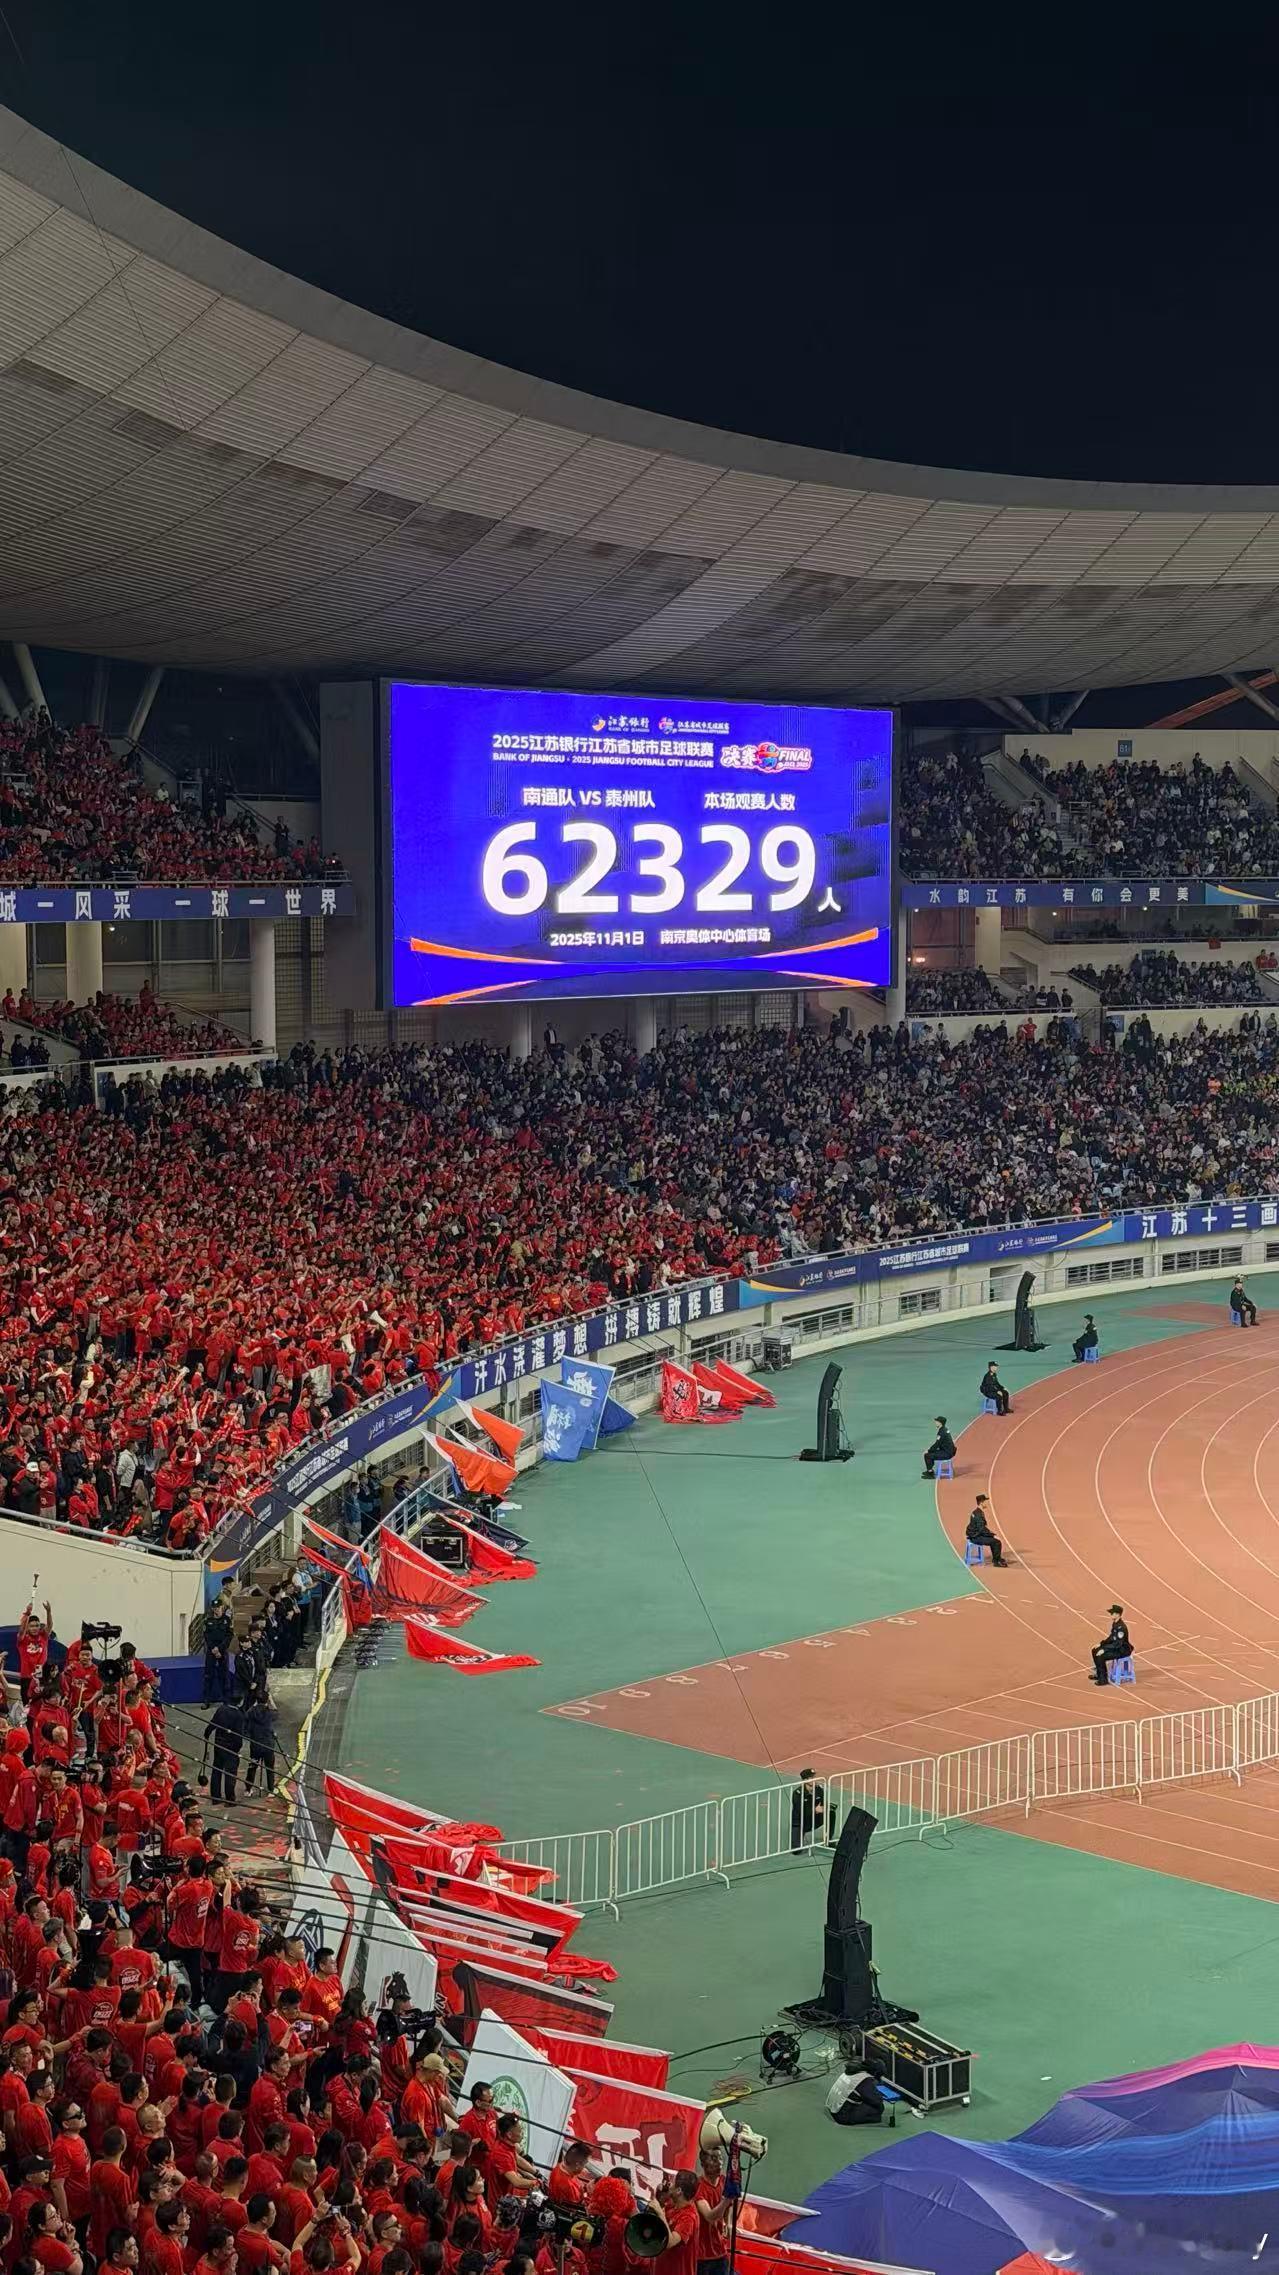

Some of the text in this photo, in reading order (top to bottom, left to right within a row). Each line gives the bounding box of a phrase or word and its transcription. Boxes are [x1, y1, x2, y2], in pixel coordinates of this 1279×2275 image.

[493, 734, 714, 757] 2025江苏银行江苏省城市足球联赛
[779, 750, 810, 761] FINAL
[493, 752, 714, 769] BANK OF JIANGSU 2025 JIANGSU FOOTBALL CITY LEAGUE
[723, 746, 757, 767] 决赛
[523, 787, 656, 808] 南通队 VS 泰州队
[704, 792, 796, 811] 本场观赛人数
[482, 821, 842, 915] 62329 人
[175, 888, 337, 917] 一球一世界
[929, 887, 1189, 903] 水韵江苏 有你会更美
[550, 927, 771, 947] 2025年11月1日 南京奥体中心体育场
